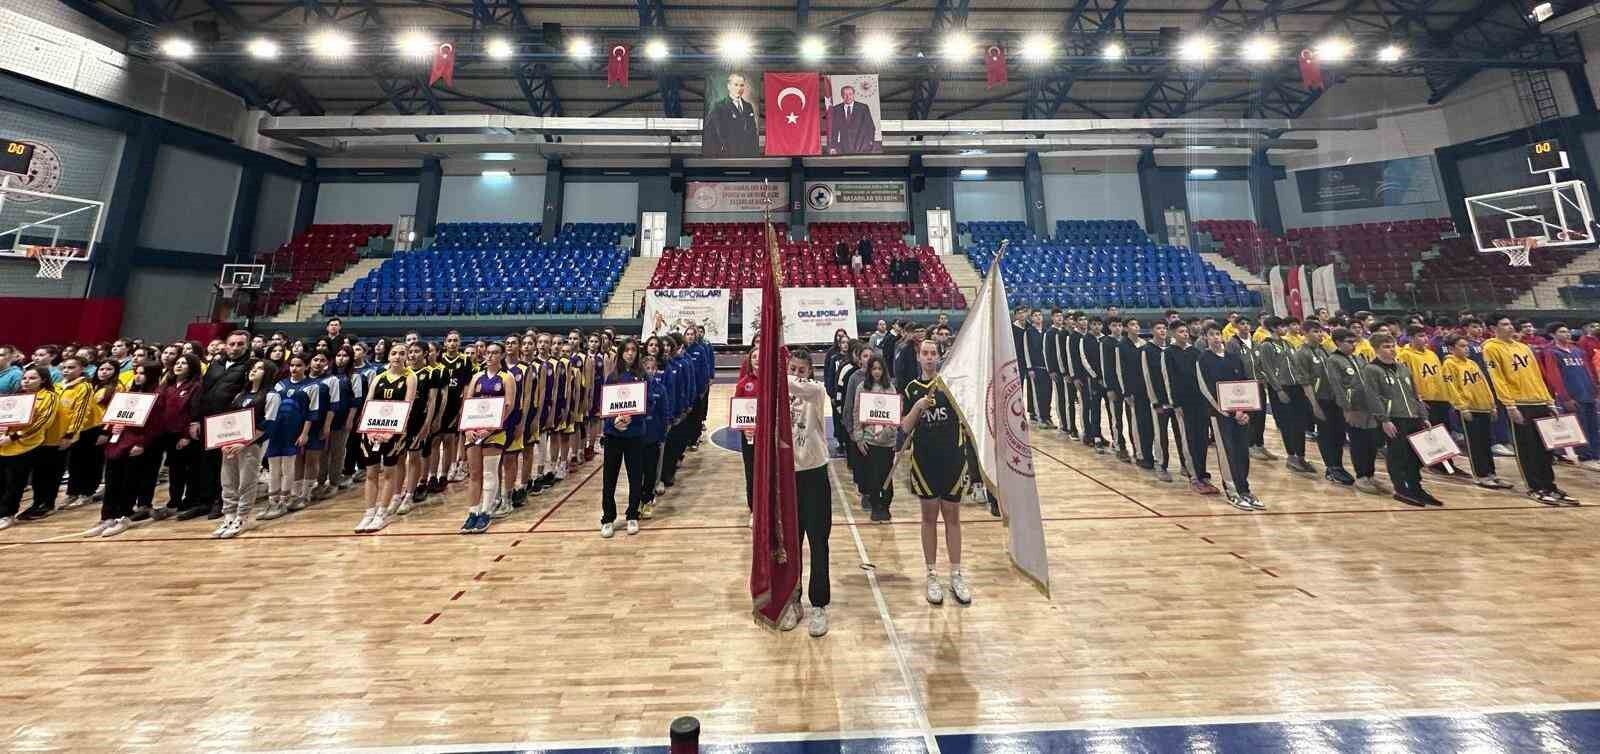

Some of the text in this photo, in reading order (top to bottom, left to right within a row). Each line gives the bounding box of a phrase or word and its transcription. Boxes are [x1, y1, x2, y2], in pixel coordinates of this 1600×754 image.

[654, 289, 678, 297] OKUL
[383, 389, 394, 399] 10
[609, 400, 637, 410] ANKARA
[116, 410, 135, 419] BOLU
[735, 413, 757, 424] İSTAN
[869, 408, 891, 419] DÜZCE
[367, 418, 399, 428] SAKARYA
